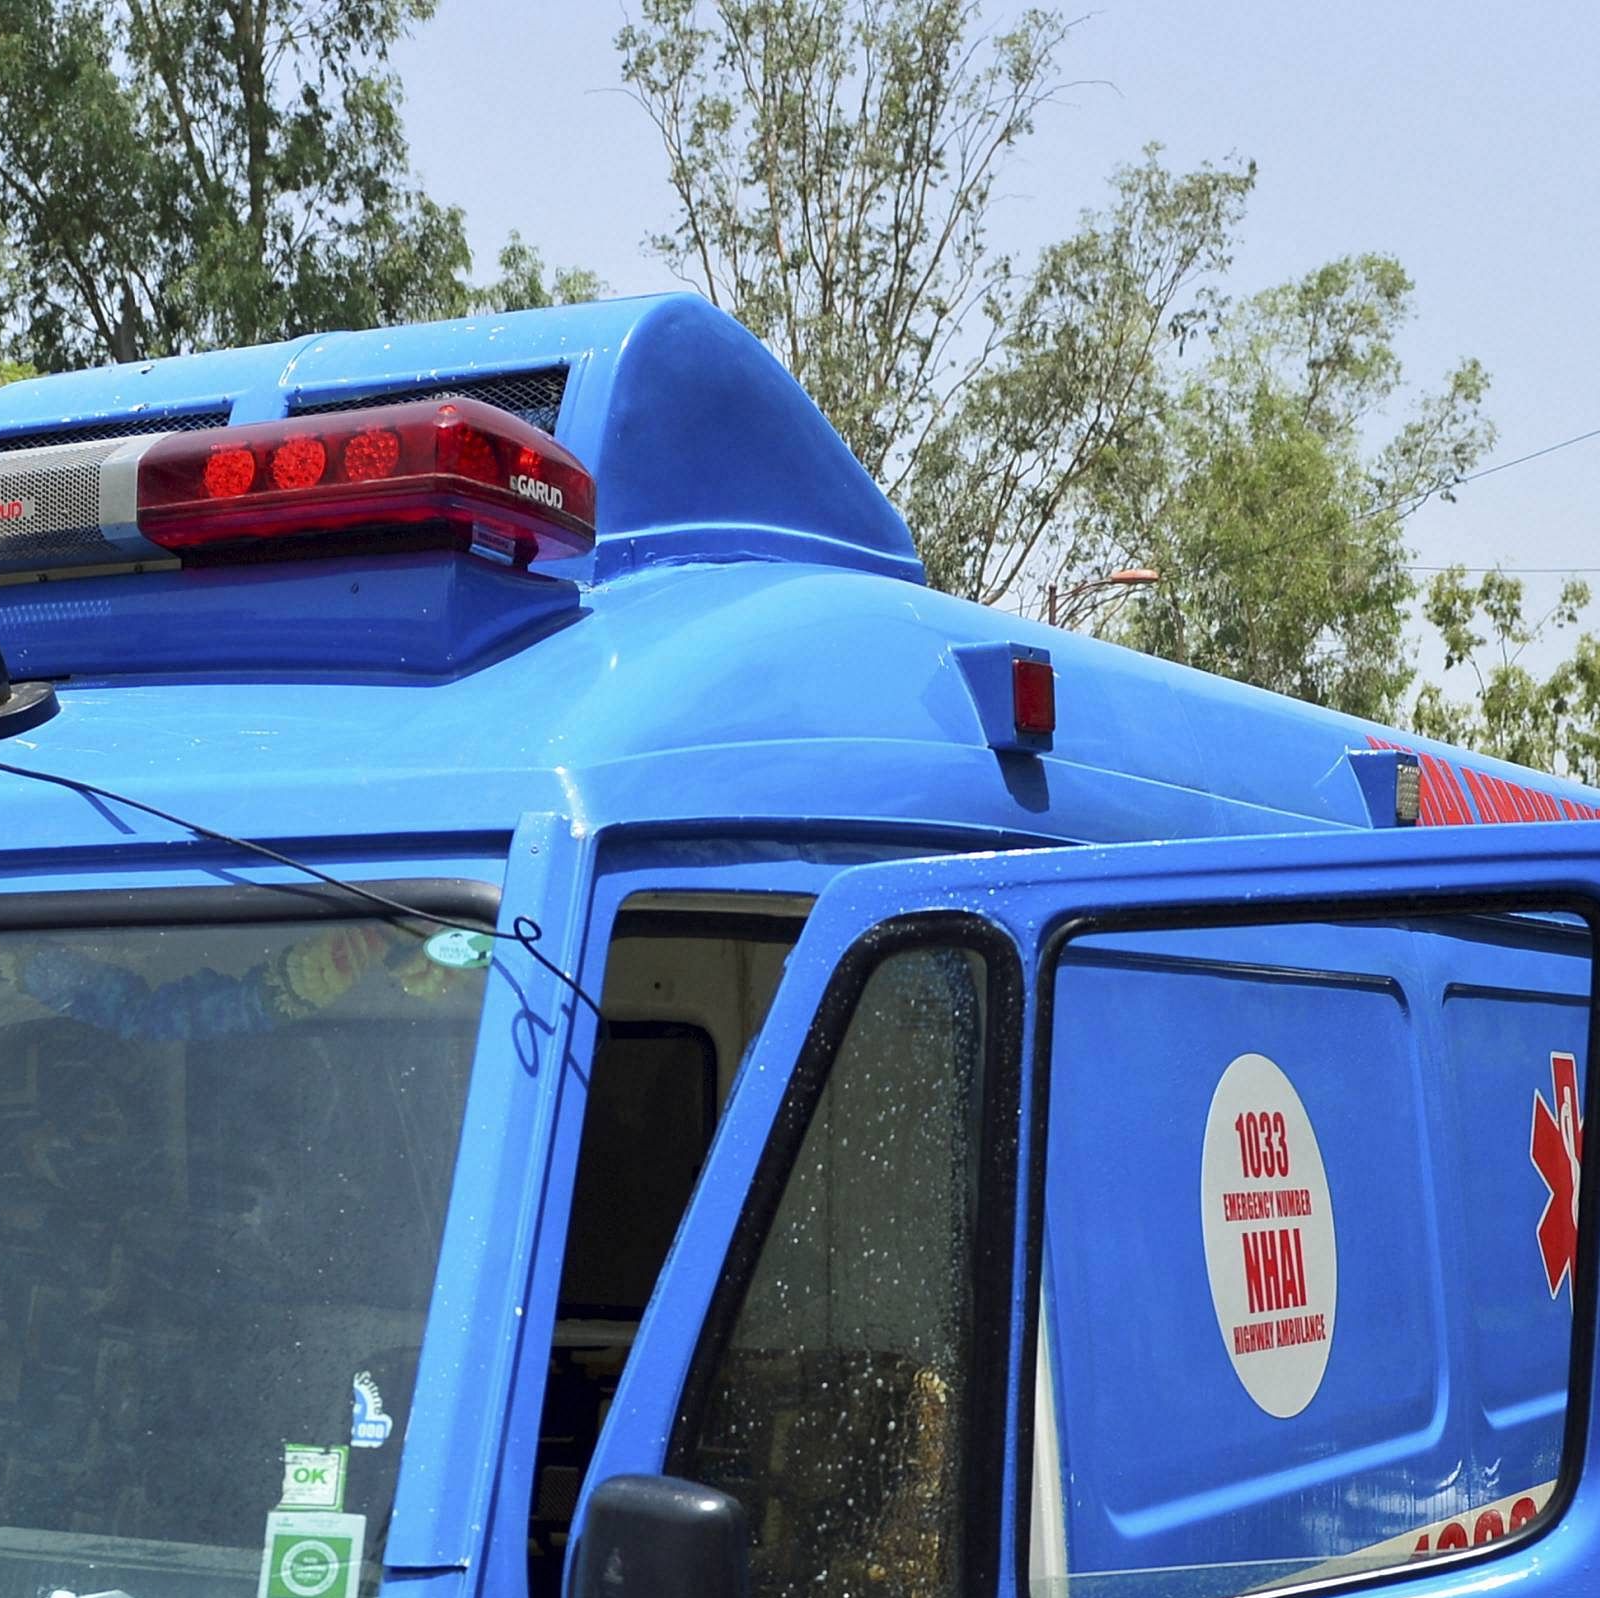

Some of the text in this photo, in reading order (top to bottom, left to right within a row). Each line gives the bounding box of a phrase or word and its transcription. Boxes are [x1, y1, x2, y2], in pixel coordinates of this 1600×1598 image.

[518, 475, 563, 509] GARUD
[1235, 1111, 1289, 1178] 1033
[1223, 1188, 1312, 1222] EMERGENCY NUMBER
[1241, 1228, 1308, 1314] NHAI
[1234, 1313, 1327, 1355] HIGHWAY AMBULANCE
[293, 1467, 328, 1485] OK
